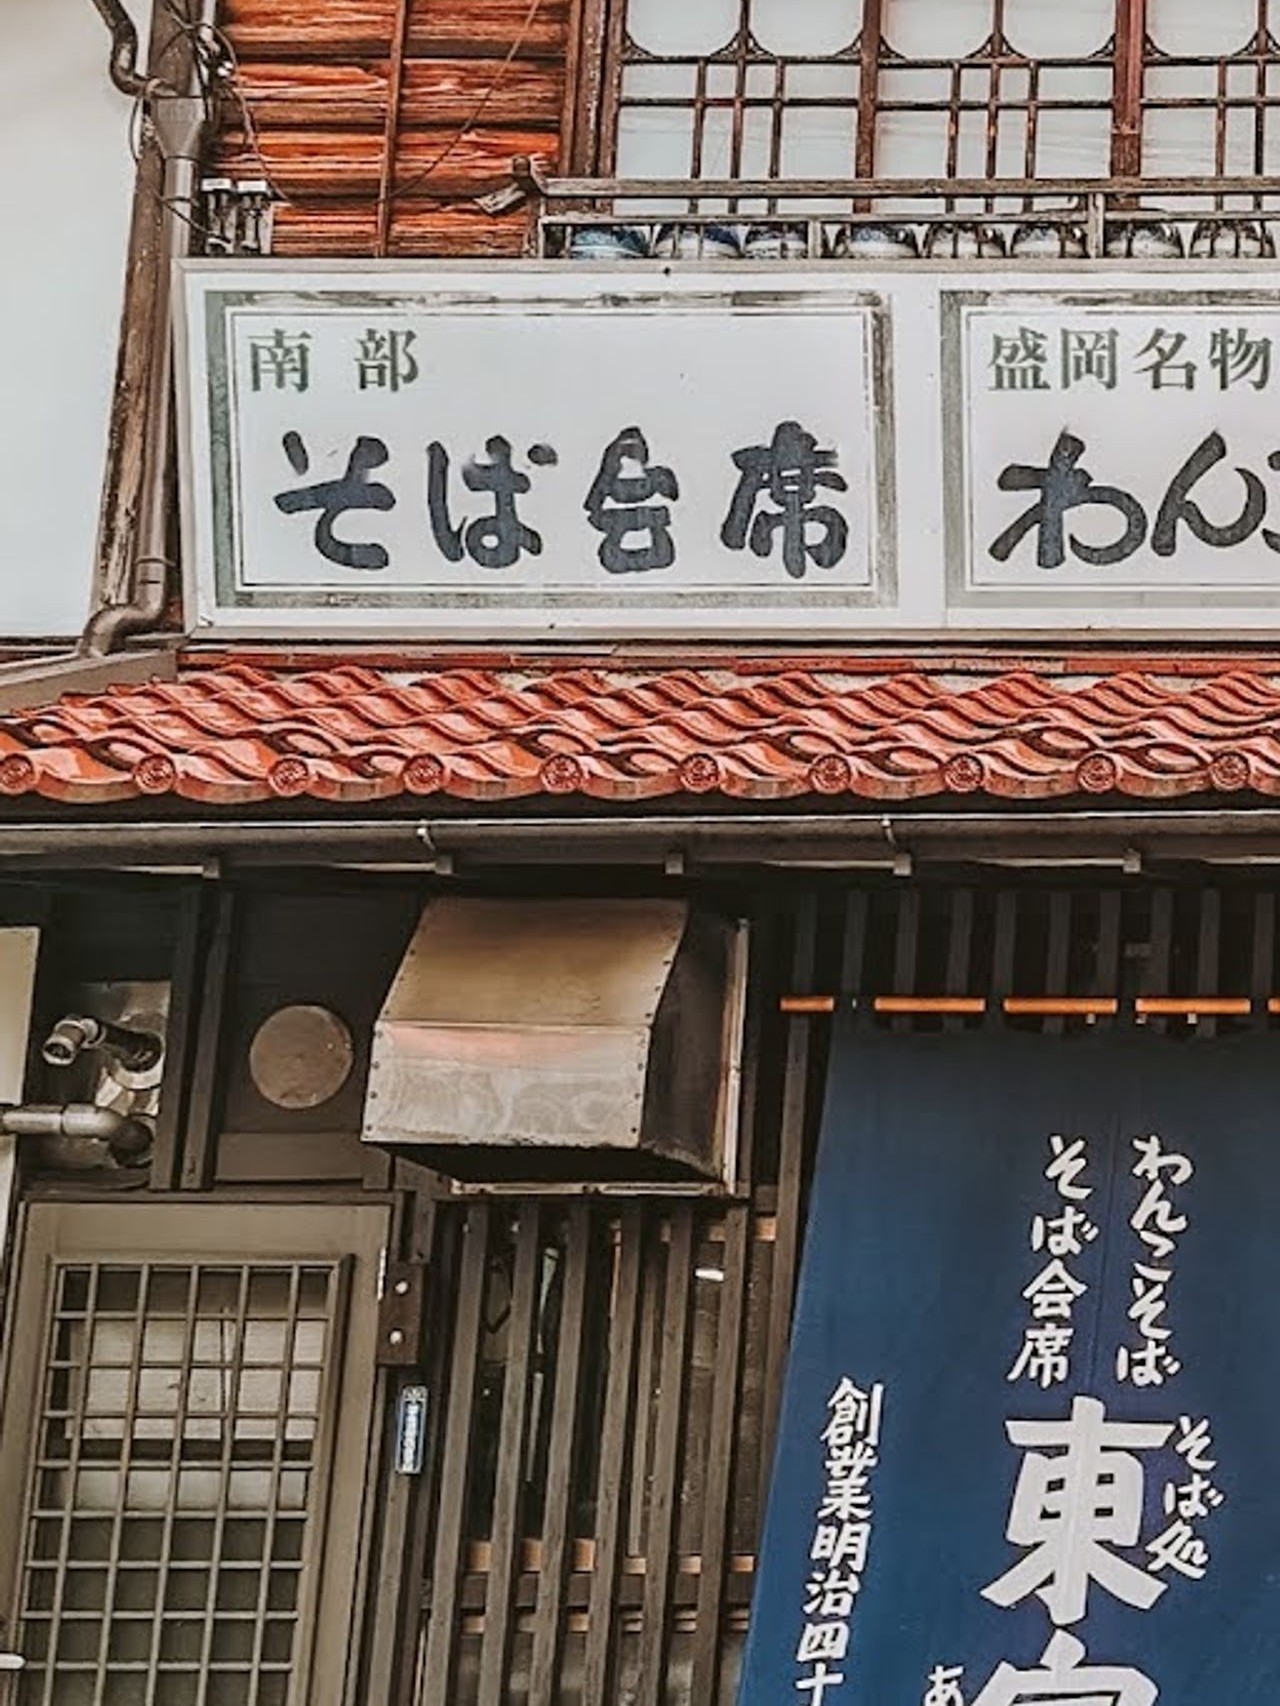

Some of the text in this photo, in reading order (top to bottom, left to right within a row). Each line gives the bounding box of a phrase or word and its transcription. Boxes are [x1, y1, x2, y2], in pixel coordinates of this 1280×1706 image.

[251, 328, 419, 393] 南部
[987, 326, 1272, 392] 盛岡名物
[1006, 1134, 1098, 1389] そば会席
[1115, 1134, 1194, 1388] わんこそば
[1145, 1414, 1224, 1581] そば処
